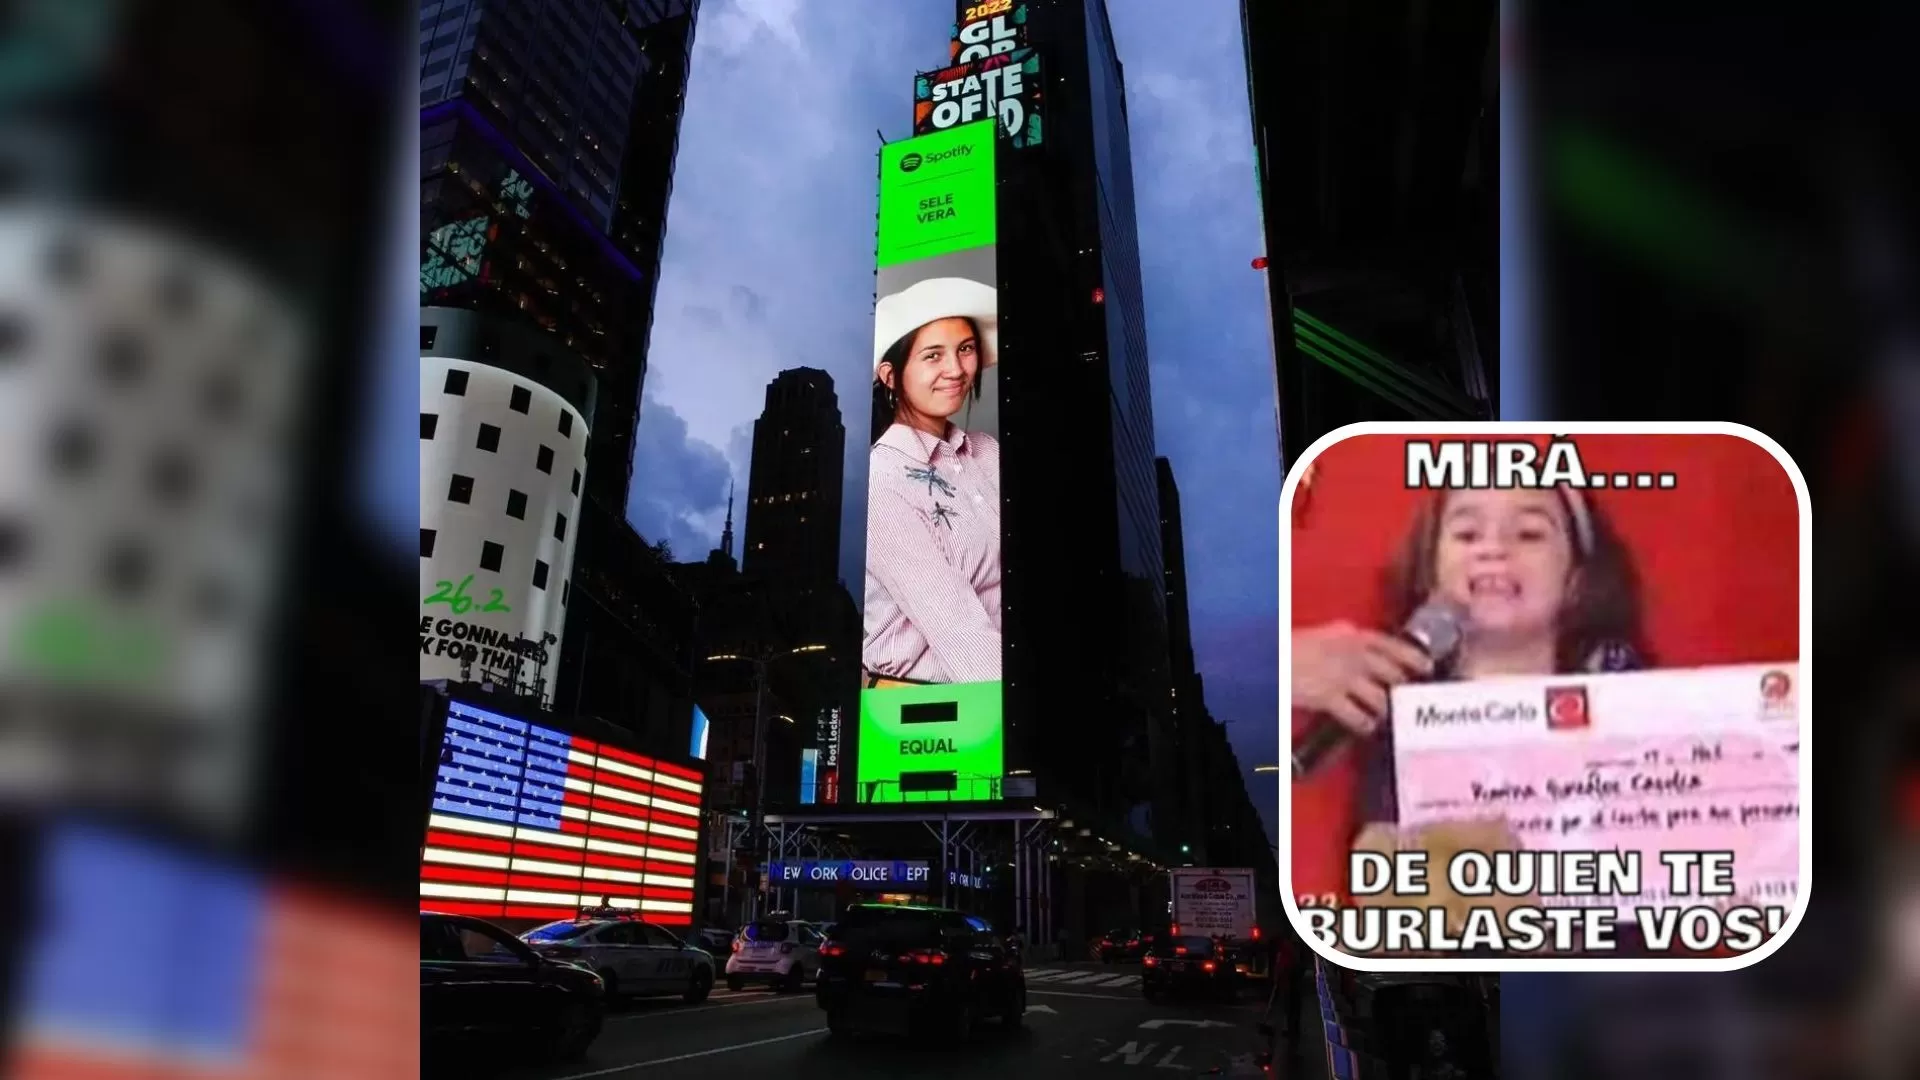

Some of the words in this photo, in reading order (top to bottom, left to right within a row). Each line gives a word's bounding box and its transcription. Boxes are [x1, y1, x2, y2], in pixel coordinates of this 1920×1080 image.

[924, 144, 976, 164] Spotify
[918, 192, 955, 210] SELE
[916, 206, 956, 225] VERA
[423, 573, 512, 615] 26.2
[436, 619, 513, 650] GONNA
[828, 708, 839, 741] Locker
[827, 743, 837, 766] Foot
[899, 738, 958, 755] EQUAL
